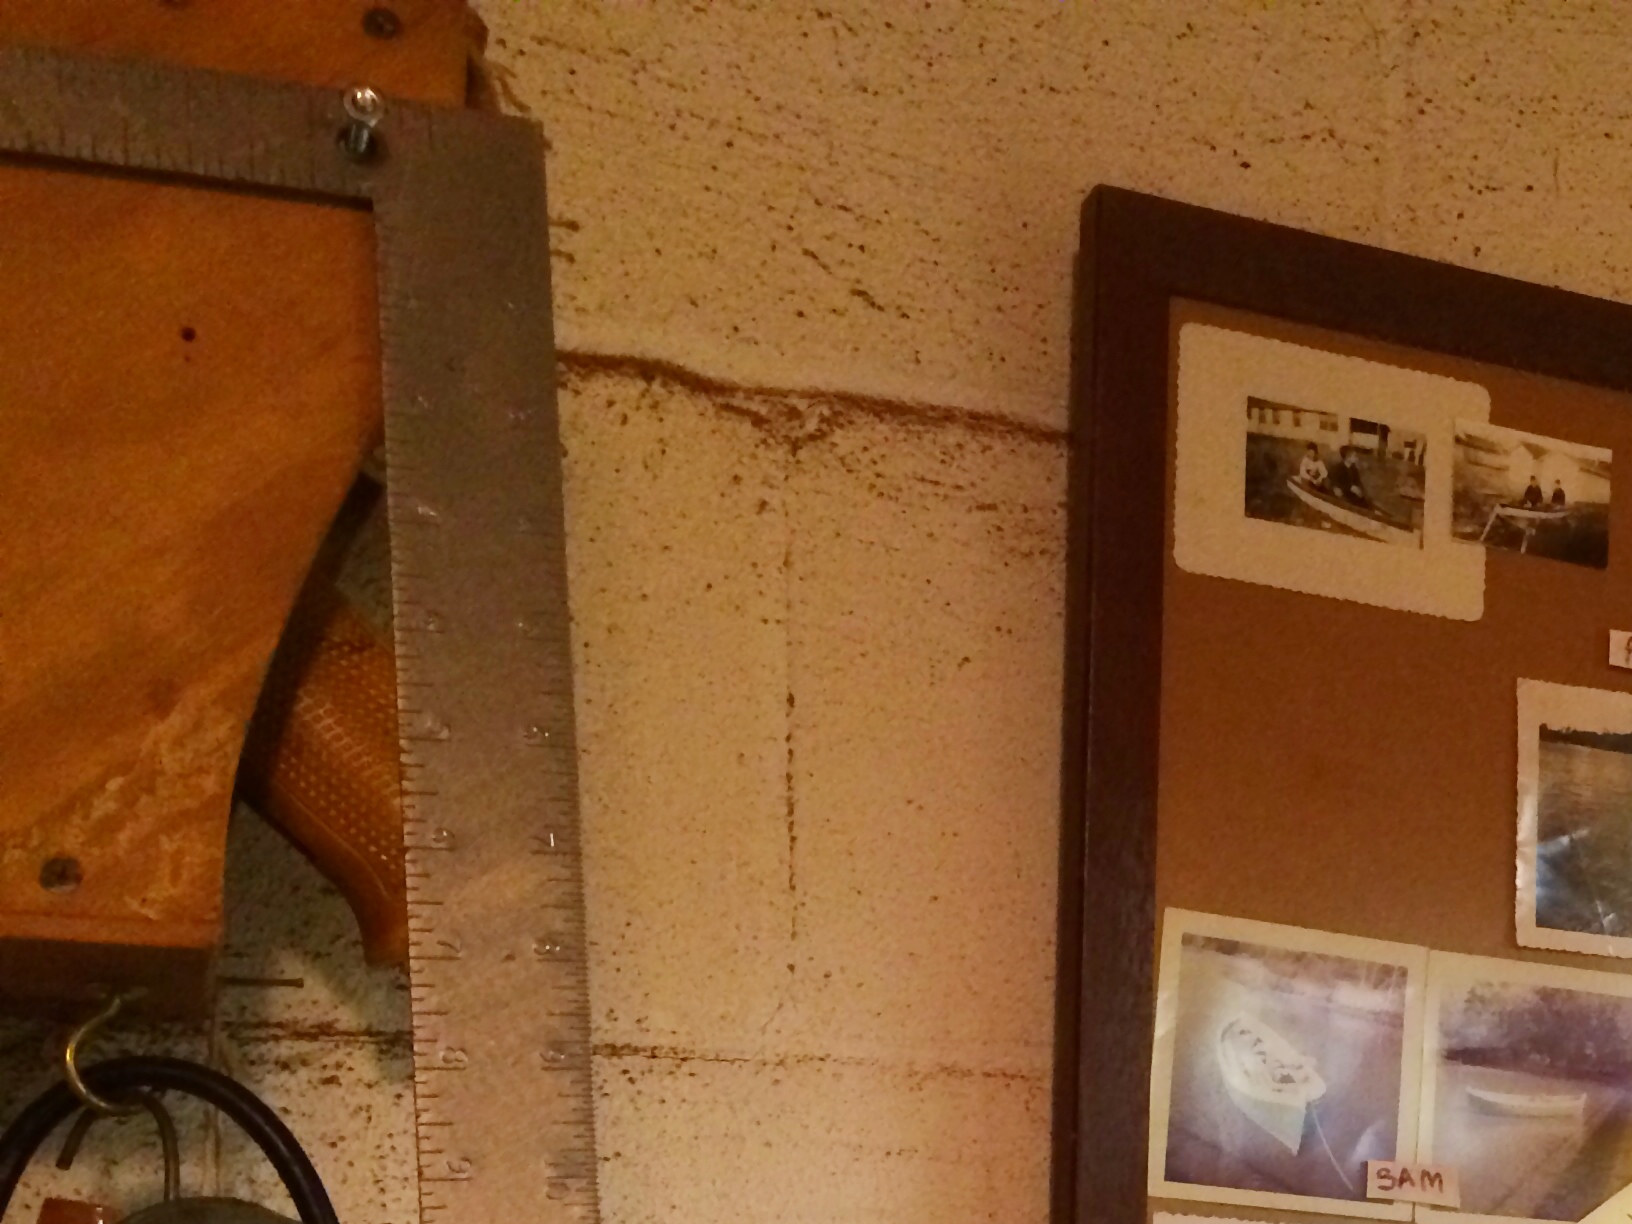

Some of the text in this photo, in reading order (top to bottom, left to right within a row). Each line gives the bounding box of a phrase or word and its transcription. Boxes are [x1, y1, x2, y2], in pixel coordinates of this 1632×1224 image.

[436, 934, 462, 954] 7
[440, 1045, 469, 1064] 8
[446, 1156, 473, 1175] 9
[1375, 1166, 1445, 1194] SAM
